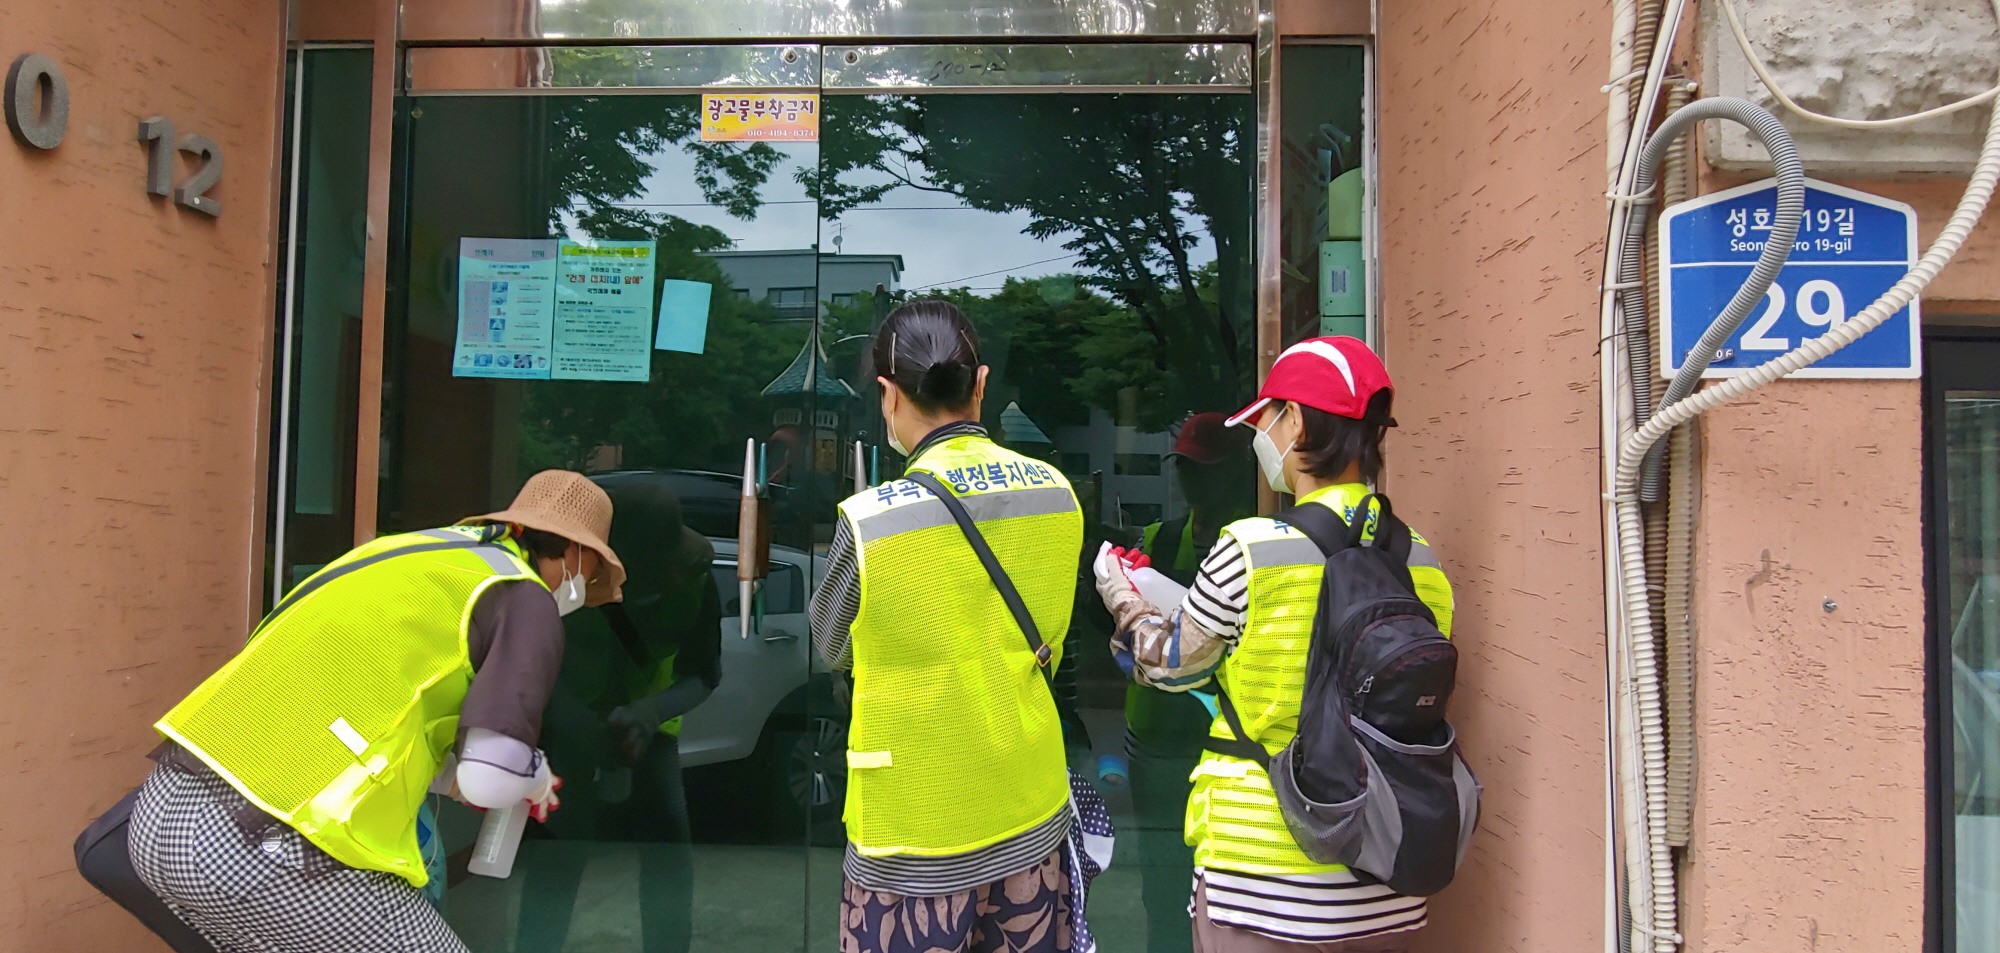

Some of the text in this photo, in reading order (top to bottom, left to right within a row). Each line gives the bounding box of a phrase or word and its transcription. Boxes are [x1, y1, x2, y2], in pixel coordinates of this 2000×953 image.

[708, 98, 814, 122] 광고물부착금지
[4, 53, 224, 219] 0 12
[1725, 207, 1855, 237] 성호19길
[1814, 238, 1852, 254] 19-gil
[1739, 279, 1845, 350] 29
[946, 460, 1057, 494] 행정복지센터
